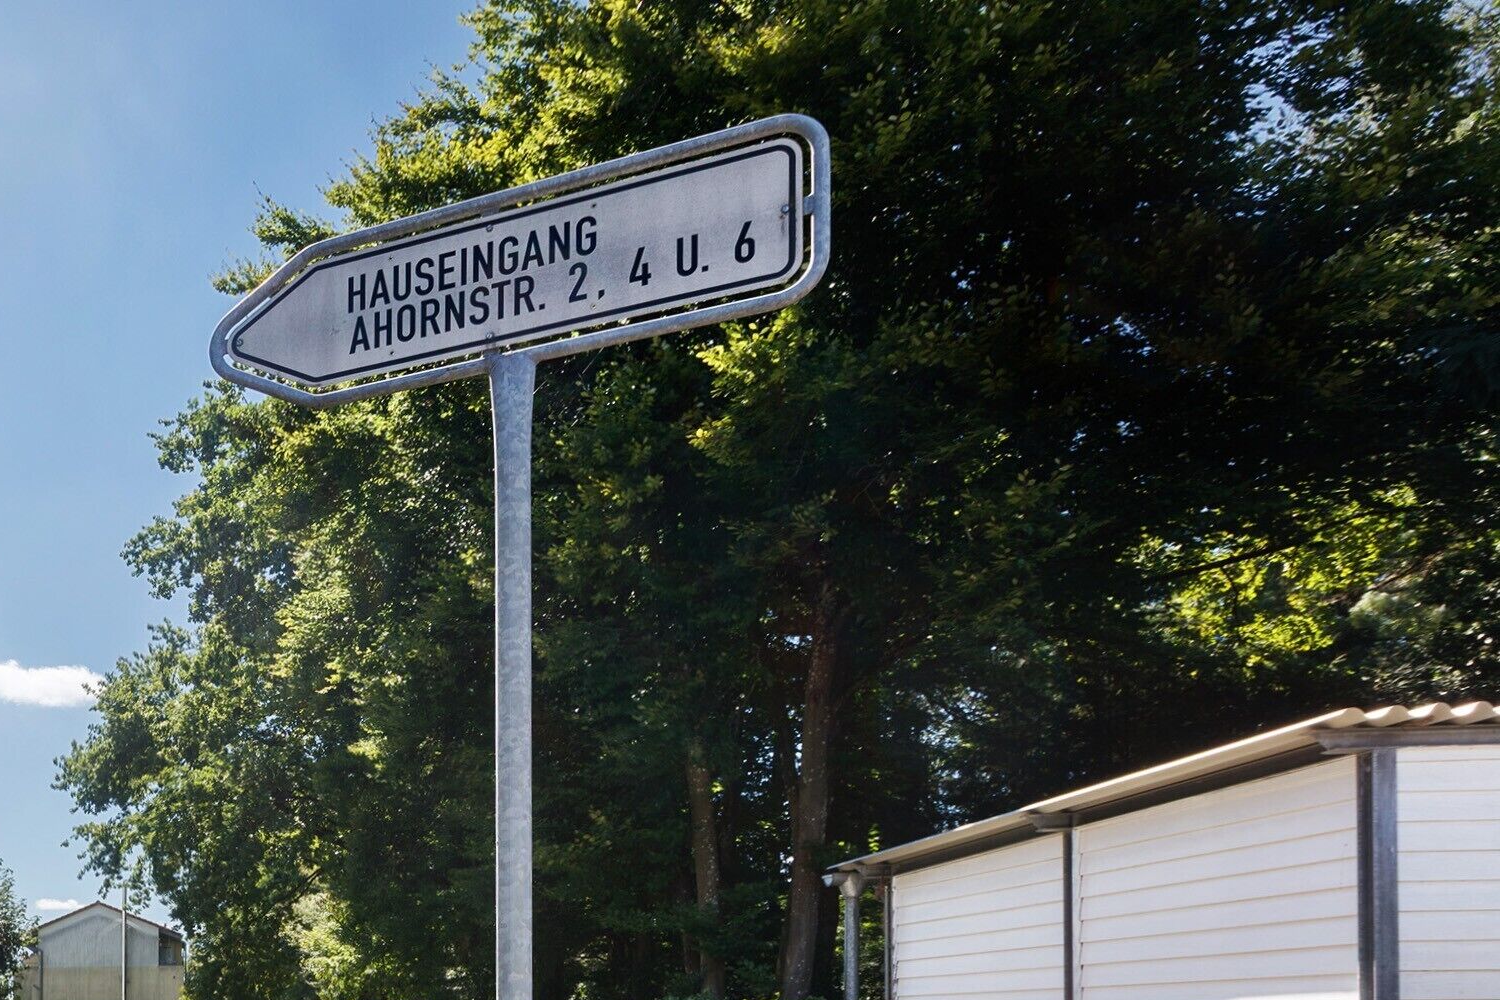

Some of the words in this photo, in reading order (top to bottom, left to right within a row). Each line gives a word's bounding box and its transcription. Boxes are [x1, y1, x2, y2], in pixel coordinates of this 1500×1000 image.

[348, 216, 597, 313] HAUSEINGANG
[349, 275, 546, 354] AHORNSTR.
[568, 262, 605, 304] 2,
[629, 246, 652, 286] 4
[676, 233, 709, 277] U.
[734, 220, 756, 264] 6
